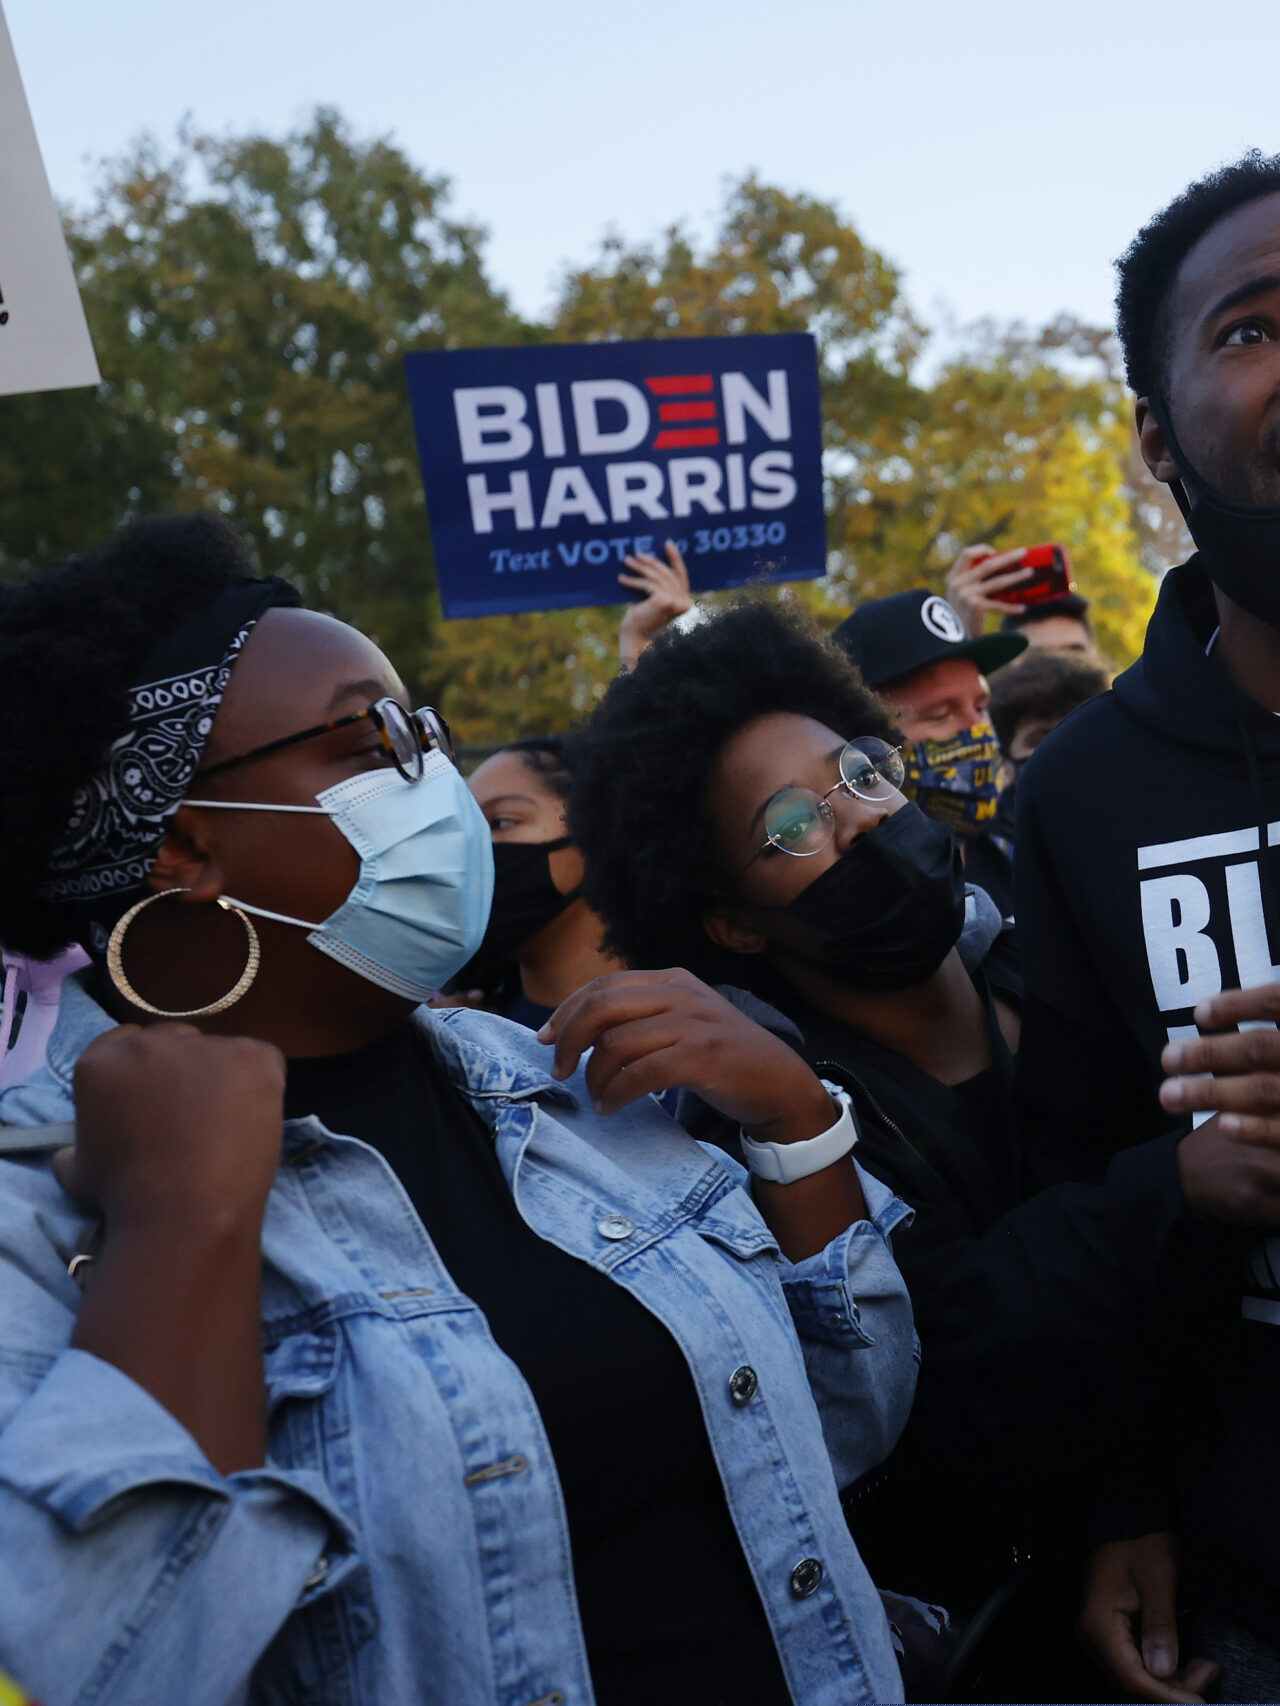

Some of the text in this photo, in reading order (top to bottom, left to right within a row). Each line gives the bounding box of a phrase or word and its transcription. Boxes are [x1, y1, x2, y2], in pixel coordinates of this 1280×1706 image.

[453, 369, 792, 464] BIDEN
[466, 450, 797, 534] HARRIS
[489, 548, 552, 573] Text
[557, 535, 655, 567] VOTE
[694, 520, 787, 555] 30330
